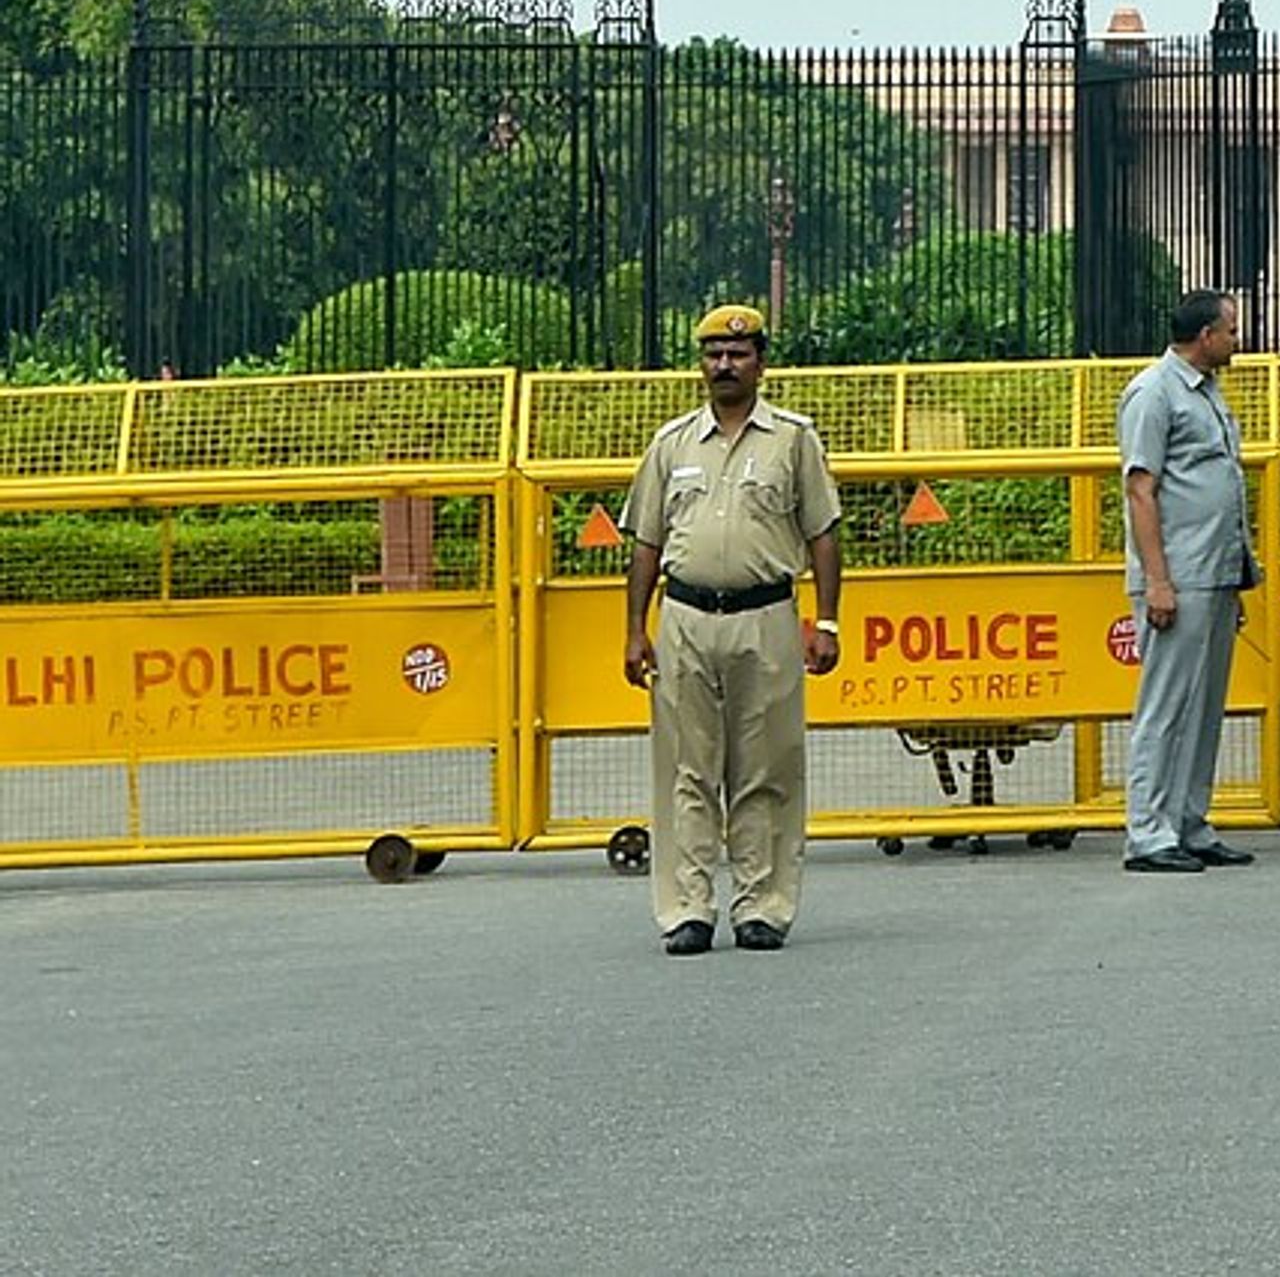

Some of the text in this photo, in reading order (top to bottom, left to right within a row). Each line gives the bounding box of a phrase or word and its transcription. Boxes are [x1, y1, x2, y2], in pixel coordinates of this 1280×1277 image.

[863, 613, 1058, 663] POLICE
[6, 643, 352, 706] LHI POLICE
[949, 670, 1067, 704] STREET
[223, 700, 350, 733] STREET
